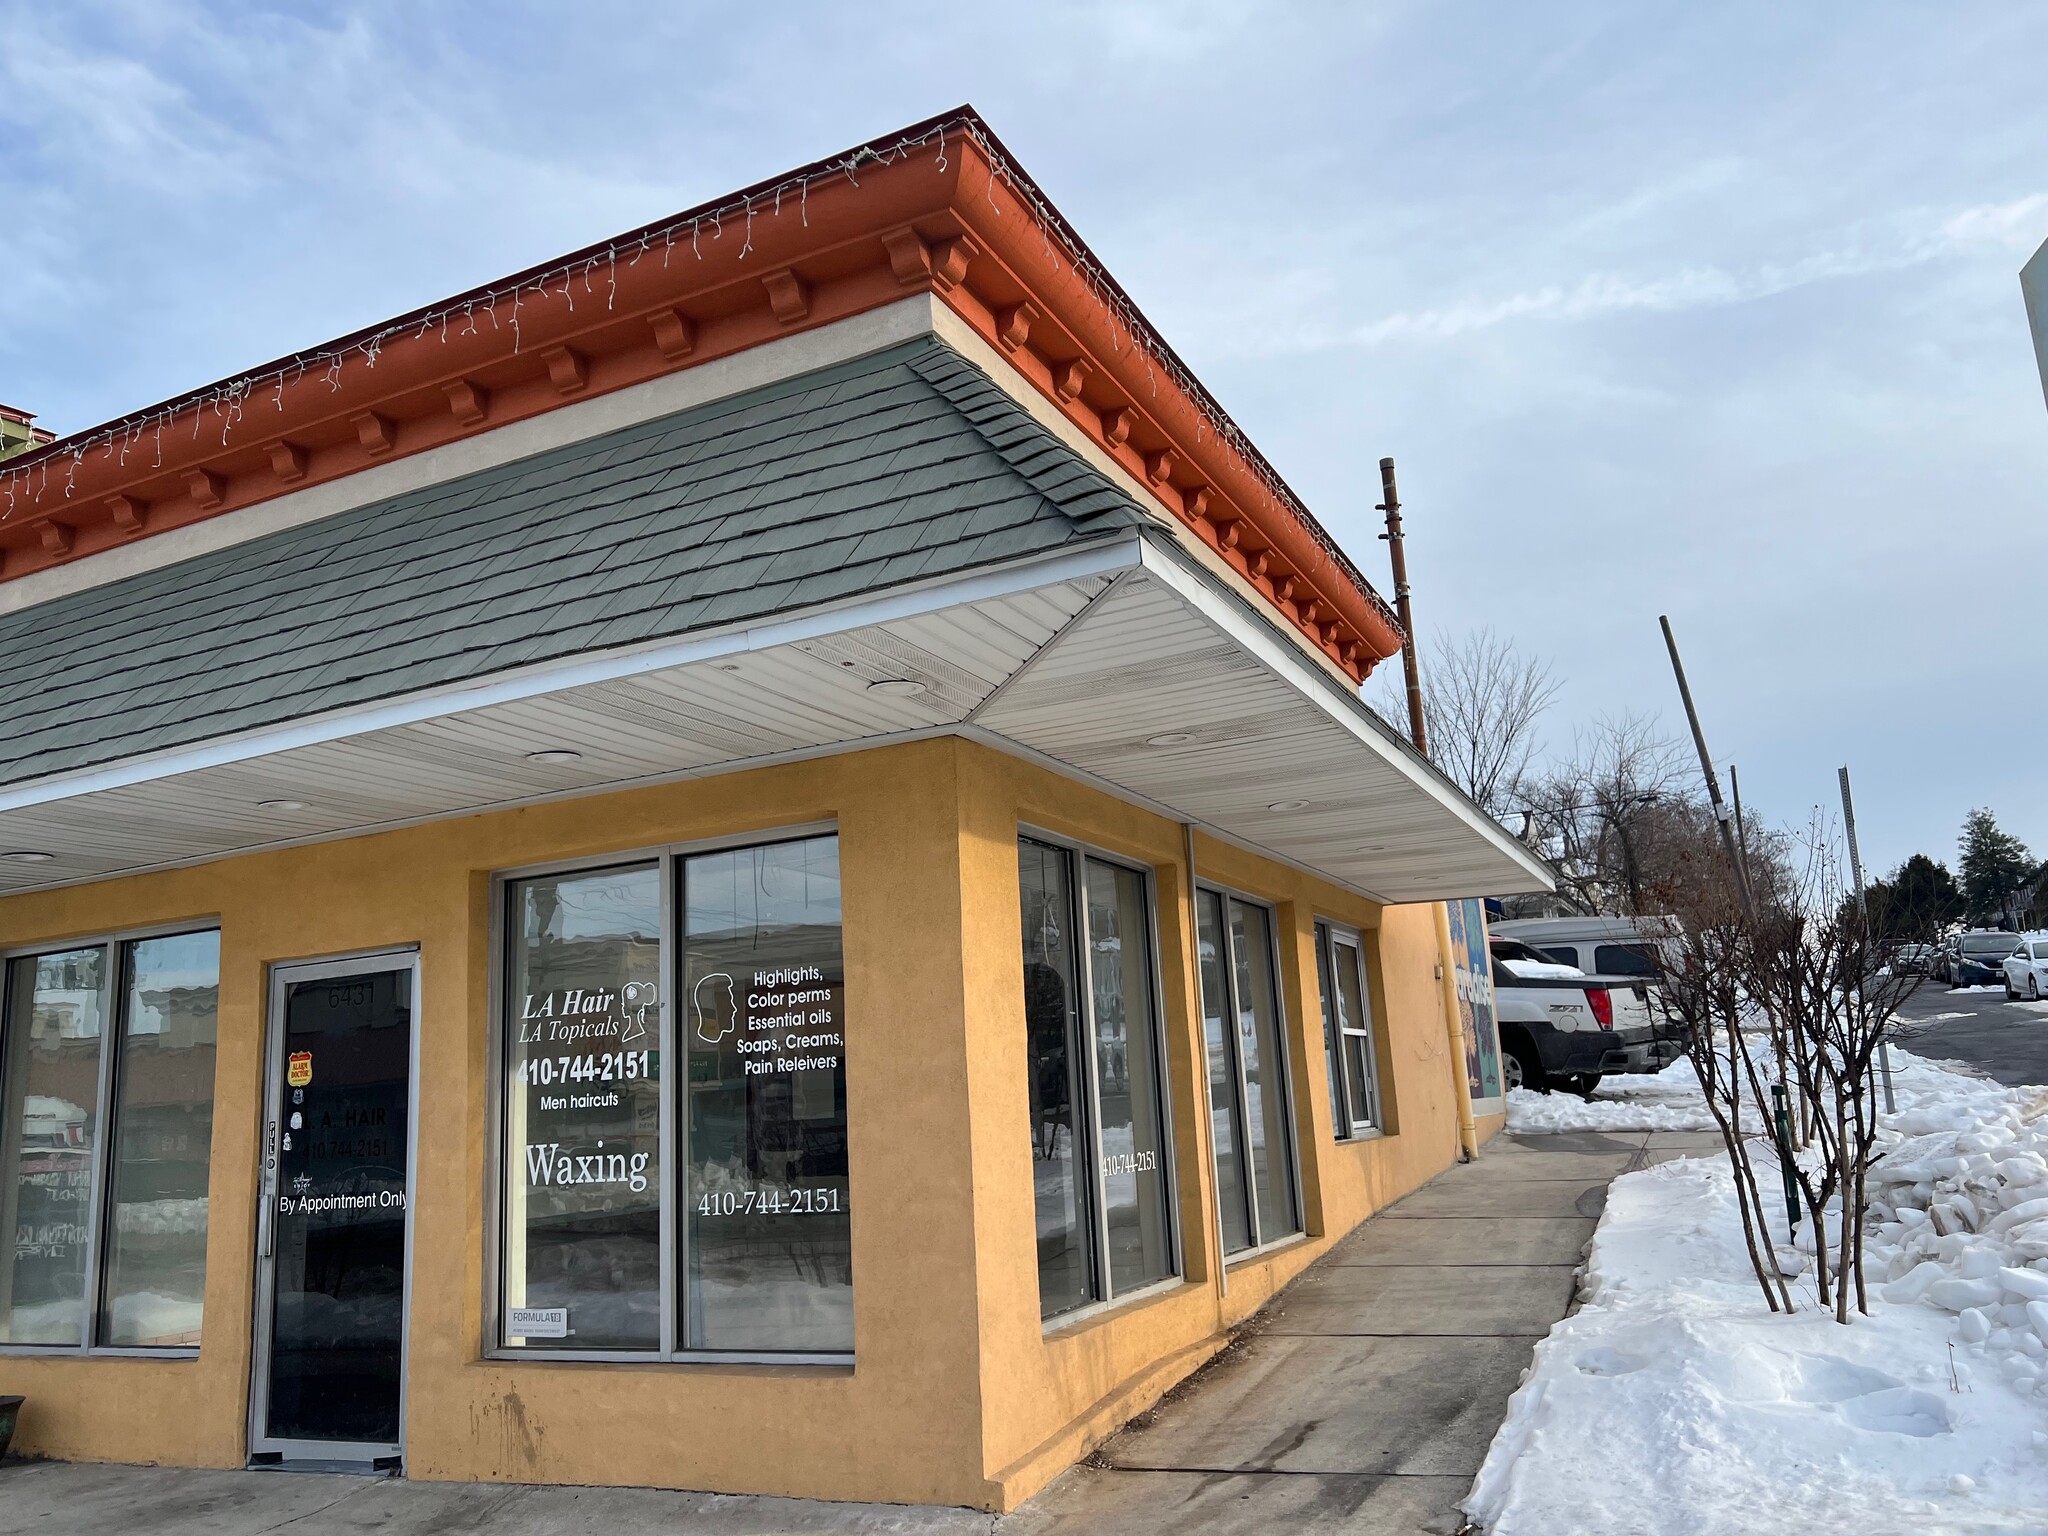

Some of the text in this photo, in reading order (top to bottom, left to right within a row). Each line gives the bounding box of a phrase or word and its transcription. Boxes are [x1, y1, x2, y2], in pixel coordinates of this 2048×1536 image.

[754, 965, 823, 988] Highlights,
[328, 982, 374, 1008] 6431
[520, 987, 615, 1019] LA Hair
[748, 988, 831, 1008] Color perms
[748, 1008, 832, 1030] Essential oils
[1549, 1004, 1584, 1012] Z71
[518, 1015, 619, 1044] LA Topicals
[736, 1033, 843, 1054] Soaps, Creams,
[517, 1050, 648, 1085] 410-744-2151
[745, 1055, 837, 1075] Pain Releivers
[540, 1092, 619, 1110] Men haircuts
[346, 1107, 386, 1128] HAIR
[525, 1140, 649, 1192] Waxing
[1103, 1150, 1156, 1177] 410-744-2151
[280, 1190, 407, 1215] By Appointment Only
[698, 1188, 841, 1216] 410-744-2151
